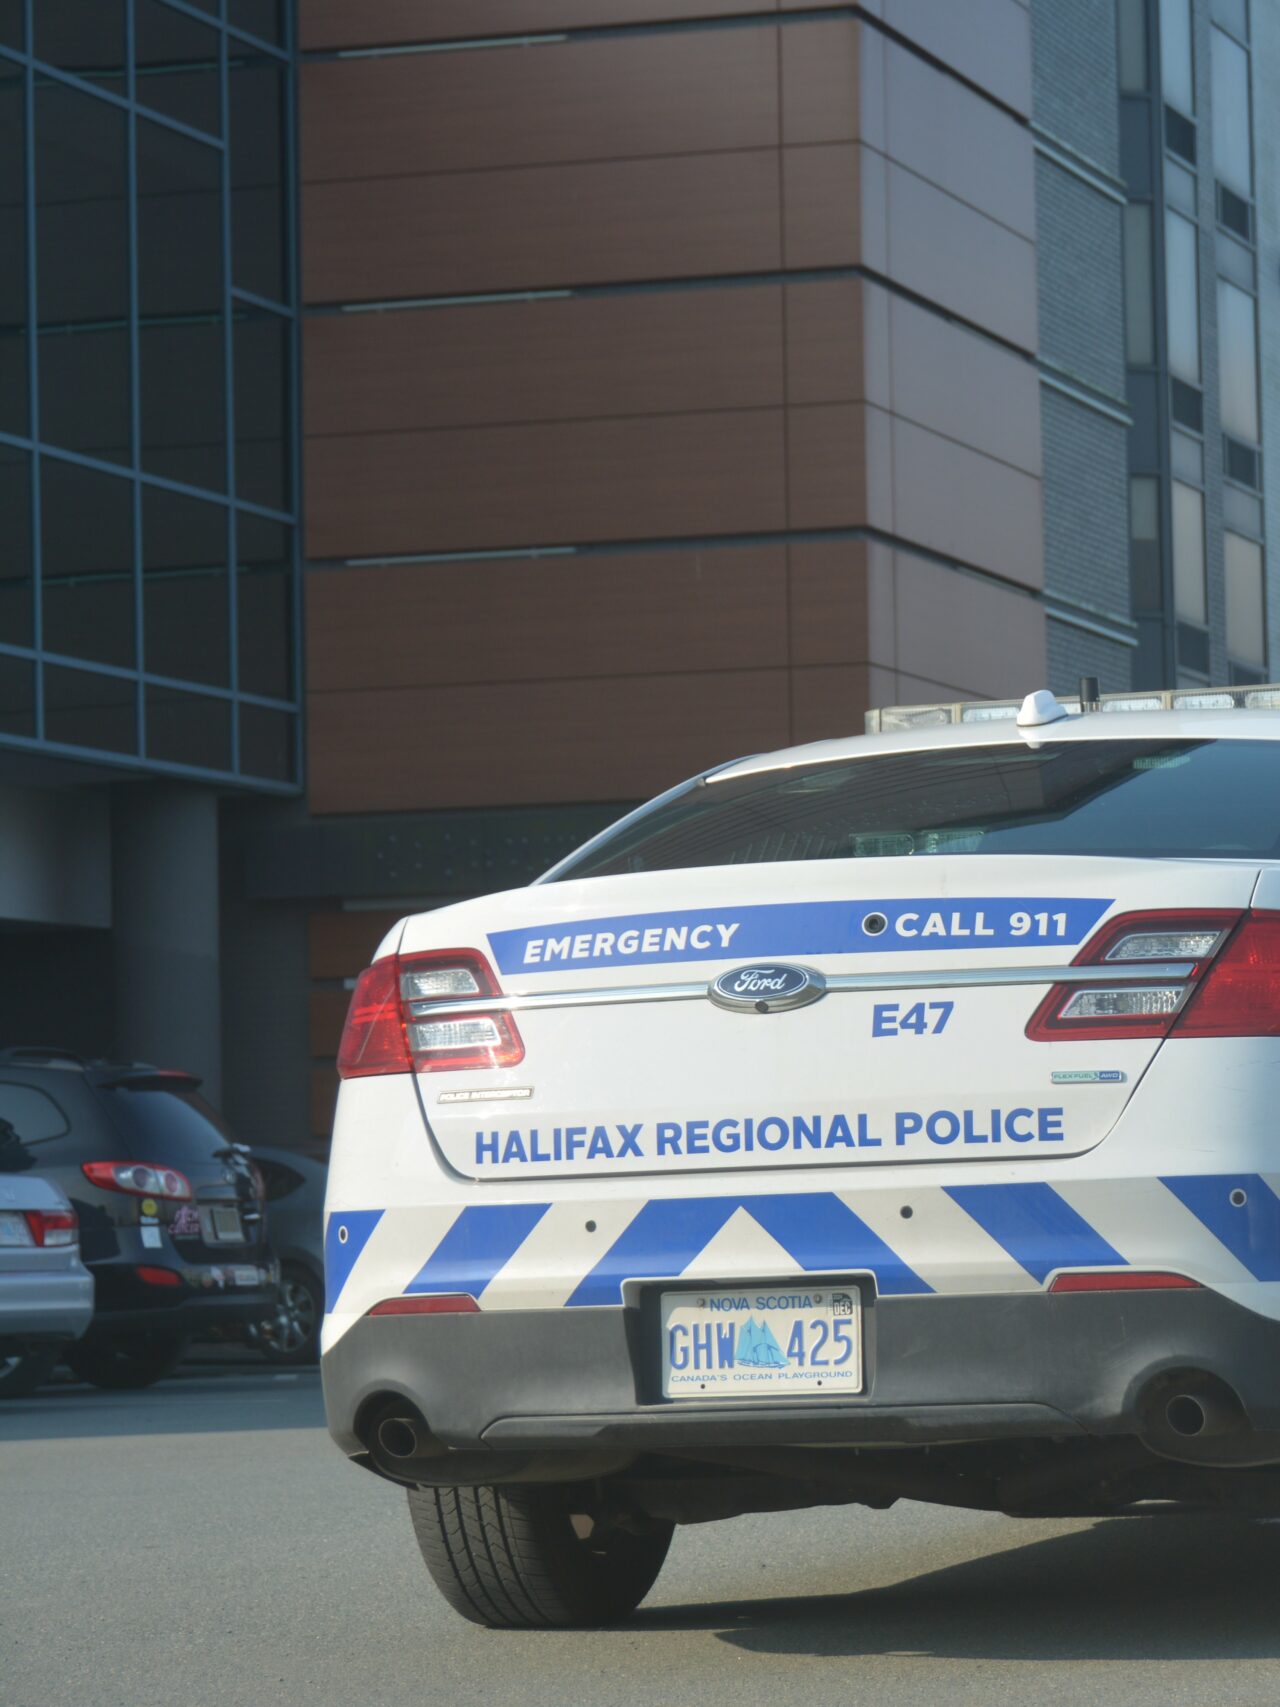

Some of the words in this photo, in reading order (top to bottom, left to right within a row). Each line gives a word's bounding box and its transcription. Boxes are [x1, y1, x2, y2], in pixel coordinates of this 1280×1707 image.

[523, 923, 741, 964] EMERGENCY
[895, 912, 995, 938] CALL
[1009, 912, 1067, 937] 911
[734, 969, 788, 992] Ford
[872, 1001, 954, 1038] E47
[1101, 1072, 1119, 1080] AWD
[475, 1123, 645, 1165] HALIFAX
[656, 1113, 882, 1156] REGIONAL
[895, 1107, 1065, 1146] POLICE
[709, 1296, 750, 1312] NOVA
[755, 1295, 813, 1310] SCOTIA
[833, 1301, 851, 1316] DEC
[669, 1322, 735, 1370] GHW
[787, 1318, 852, 1367] 425
[671, 1373, 727, 1382] CANADA'S
[733, 1372, 773, 1381] OCEAN
[778, 1370, 853, 1380] PLAYGROUND
